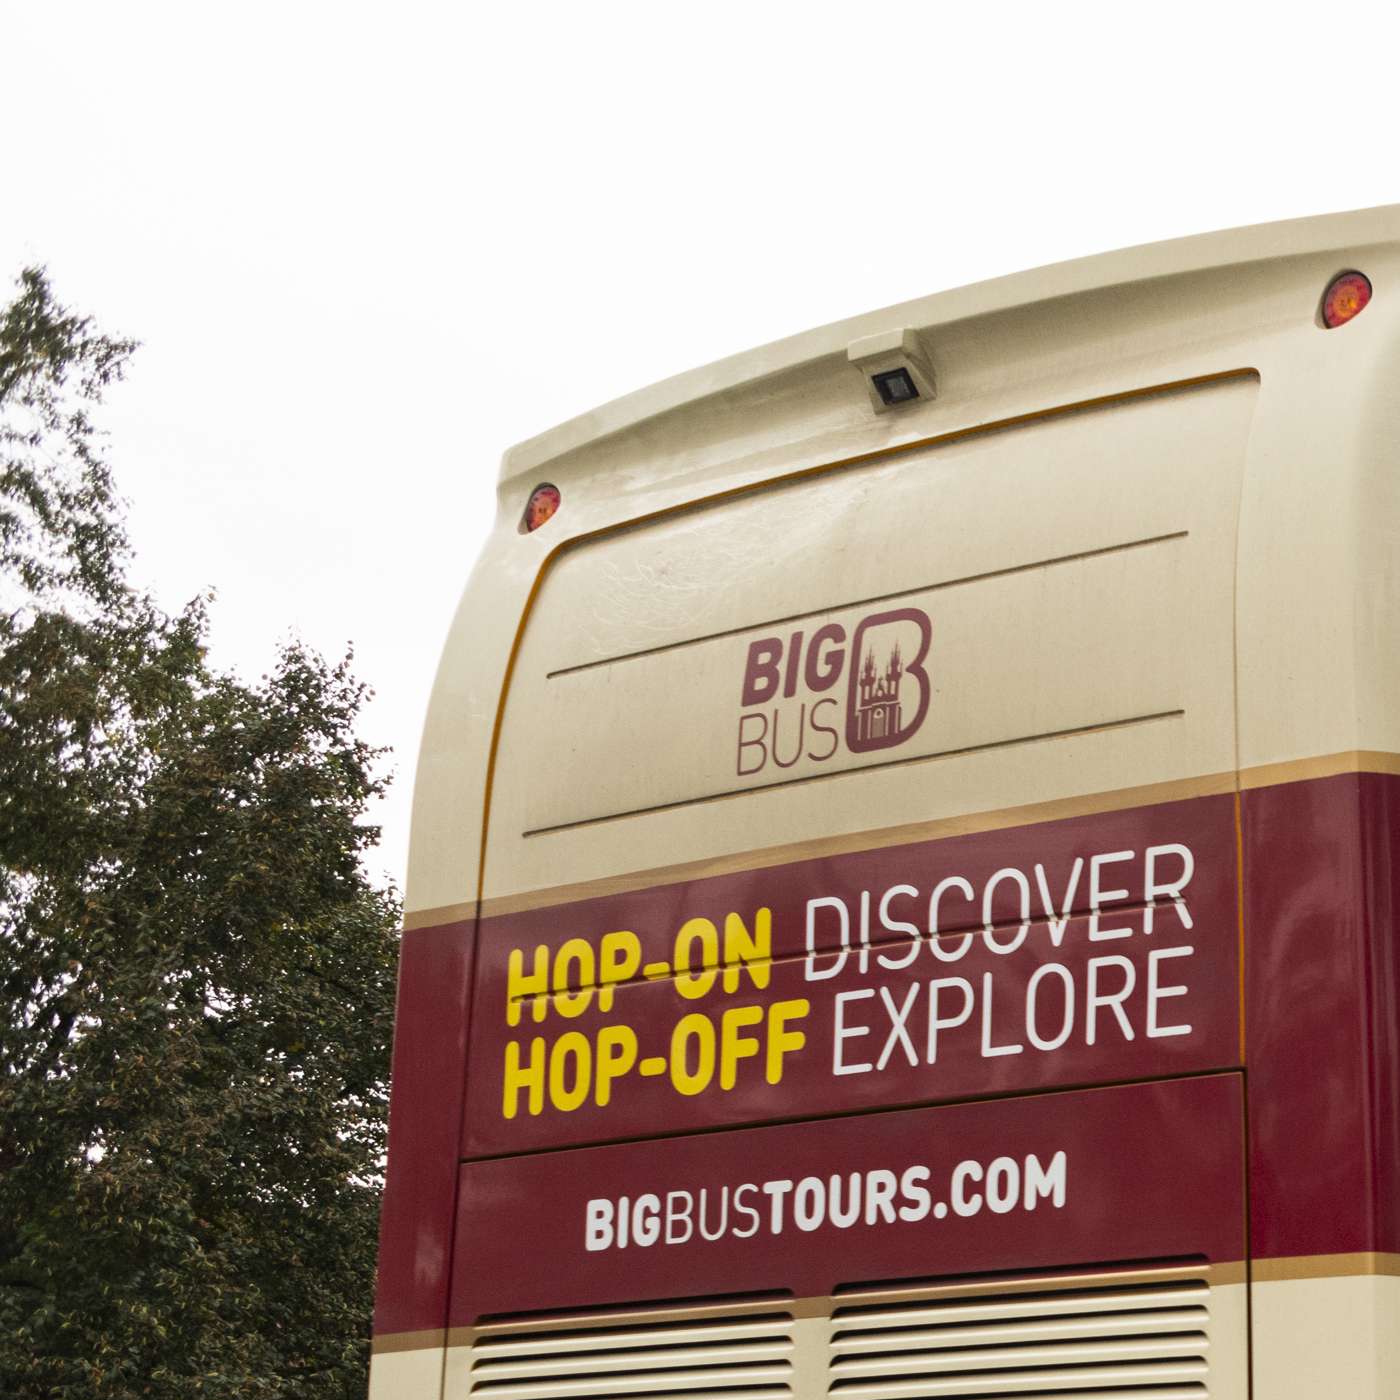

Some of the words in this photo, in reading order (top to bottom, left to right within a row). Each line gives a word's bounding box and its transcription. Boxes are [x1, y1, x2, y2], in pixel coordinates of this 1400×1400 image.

[740, 623, 847, 707] BIG
[736, 699, 839, 777] BUS
[507, 906, 771, 1027] HOP-ON
[805, 843, 1195, 981] DISCOVER
[503, 998, 809, 1120] HOP-OFF
[832, 946, 1193, 1076] EXPLORE
[585, 1151, 1066, 1252] BIGBUSTOURS.COM
